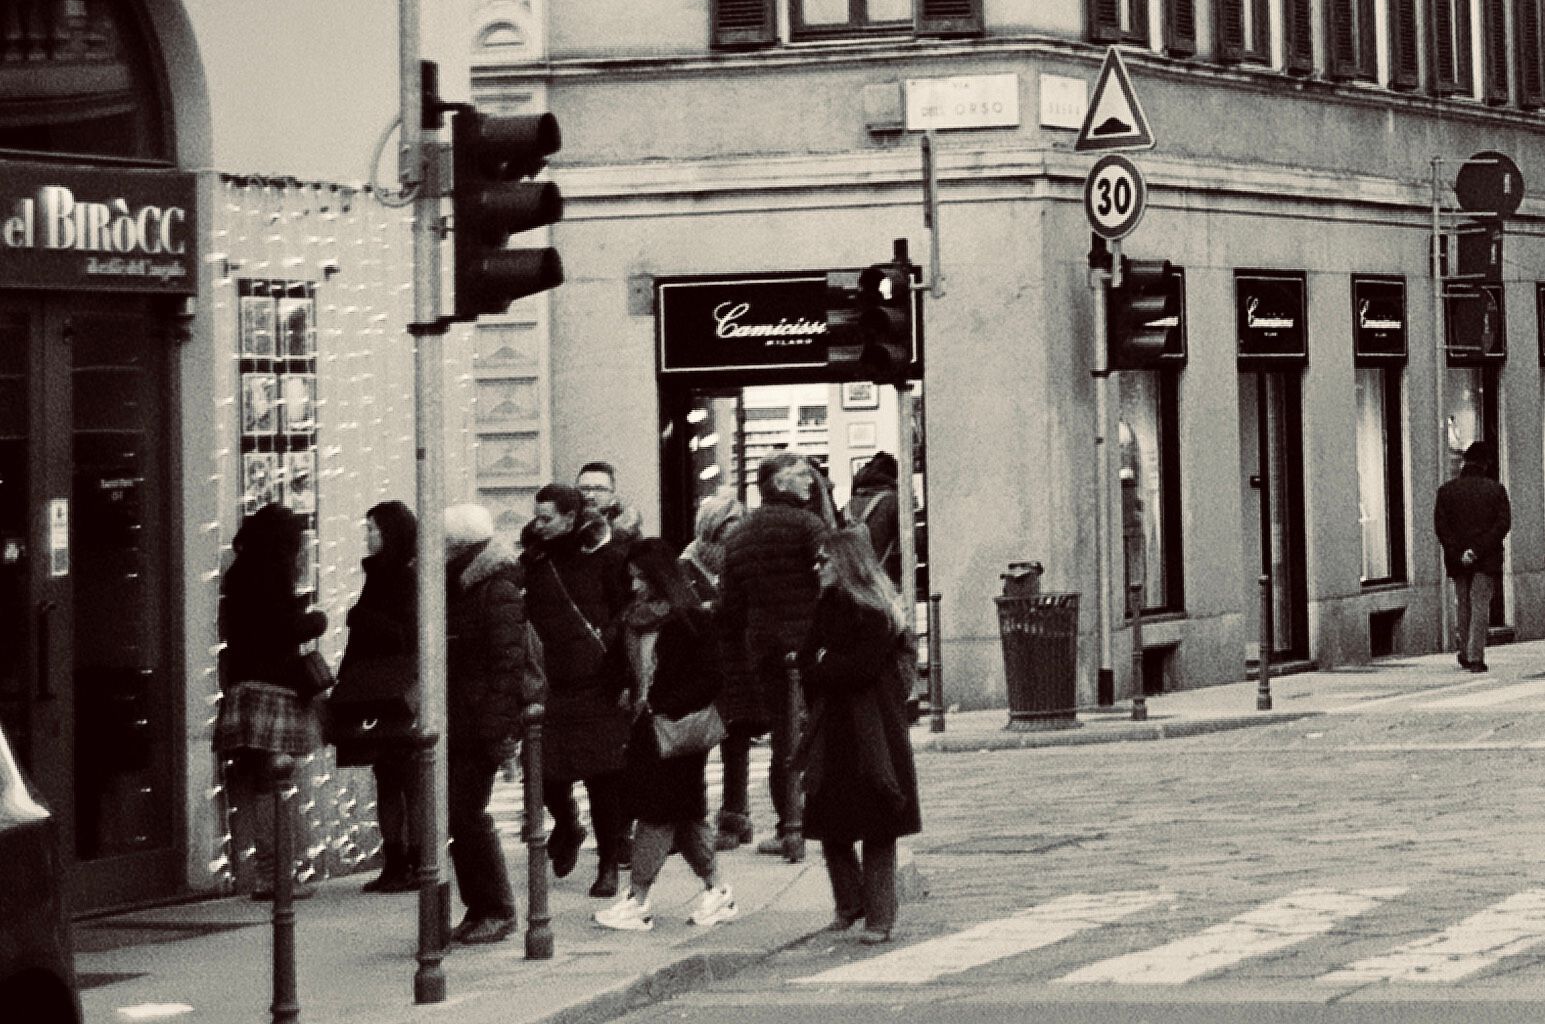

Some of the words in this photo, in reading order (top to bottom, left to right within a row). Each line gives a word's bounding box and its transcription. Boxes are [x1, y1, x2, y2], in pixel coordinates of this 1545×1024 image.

[954, 101, 1004, 116] ORSO
[1096, 176, 1132, 217] 30
[3, 197, 34, 248] el
[764, 338, 813, 347] MILANO
